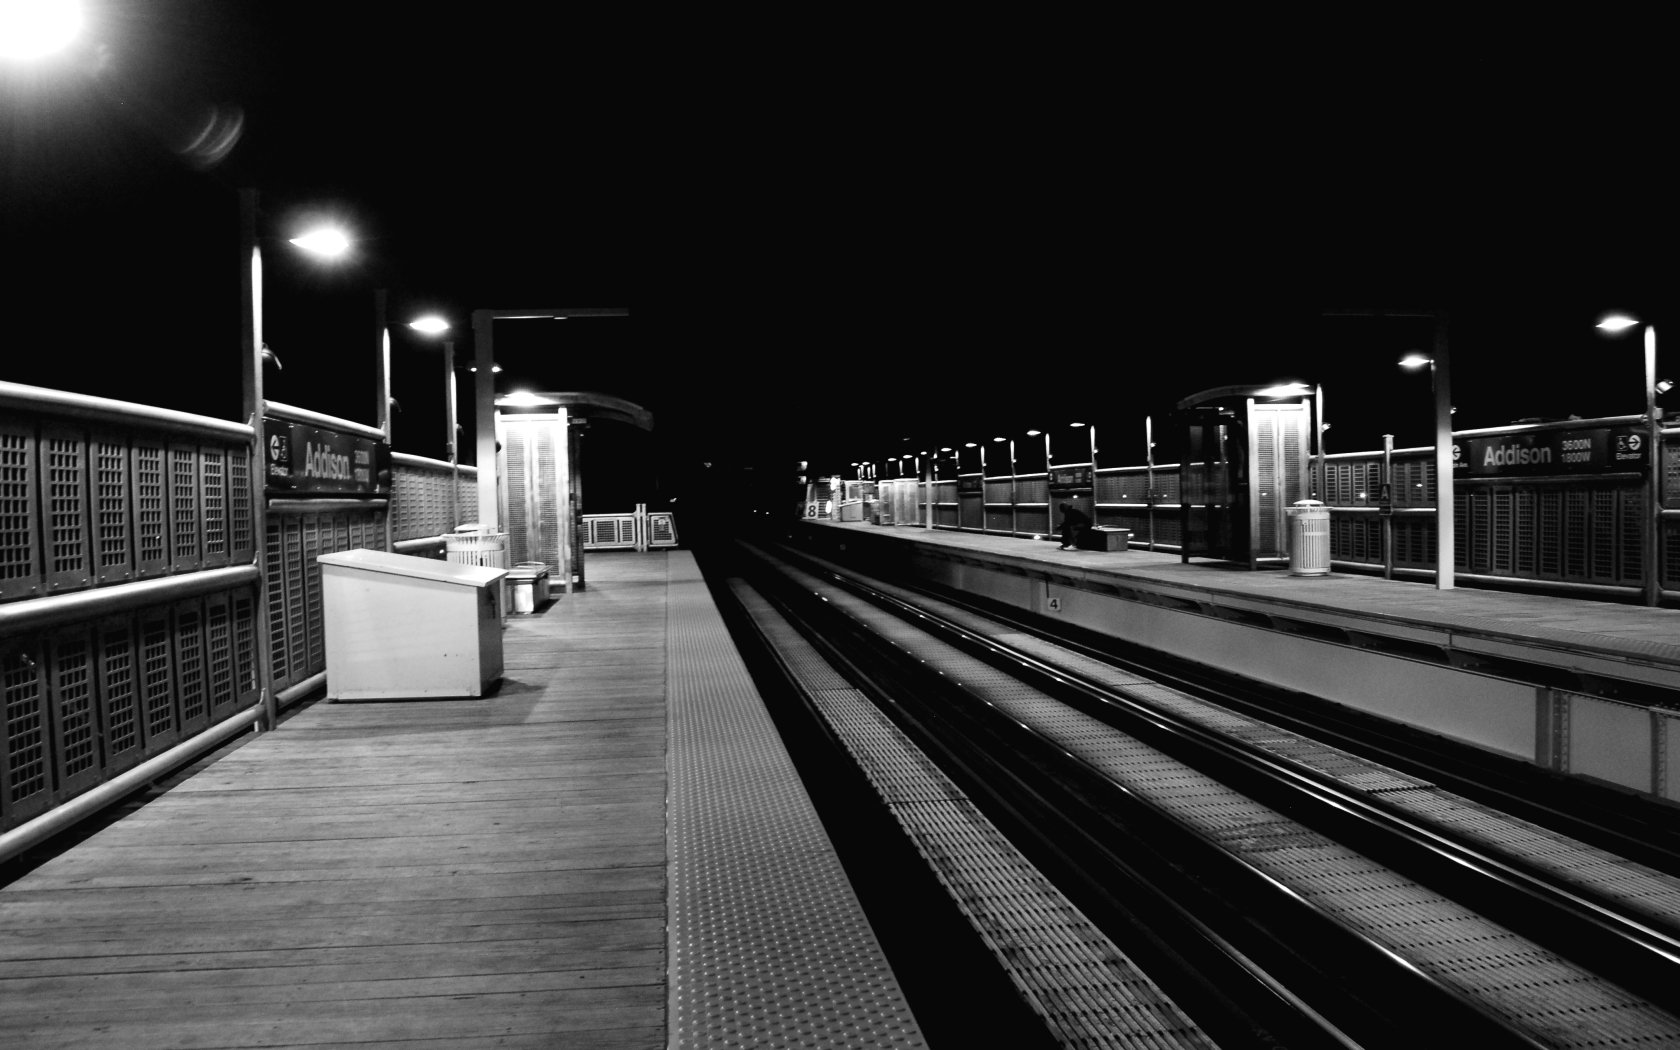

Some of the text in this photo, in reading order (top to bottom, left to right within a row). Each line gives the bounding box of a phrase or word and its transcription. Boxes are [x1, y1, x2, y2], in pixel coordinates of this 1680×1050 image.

[304, 441, 351, 480] Addison
[1483, 443, 1552, 467] Addison
[808, 505, 816, 517] 8
[1050, 598, 1058, 609] 4
